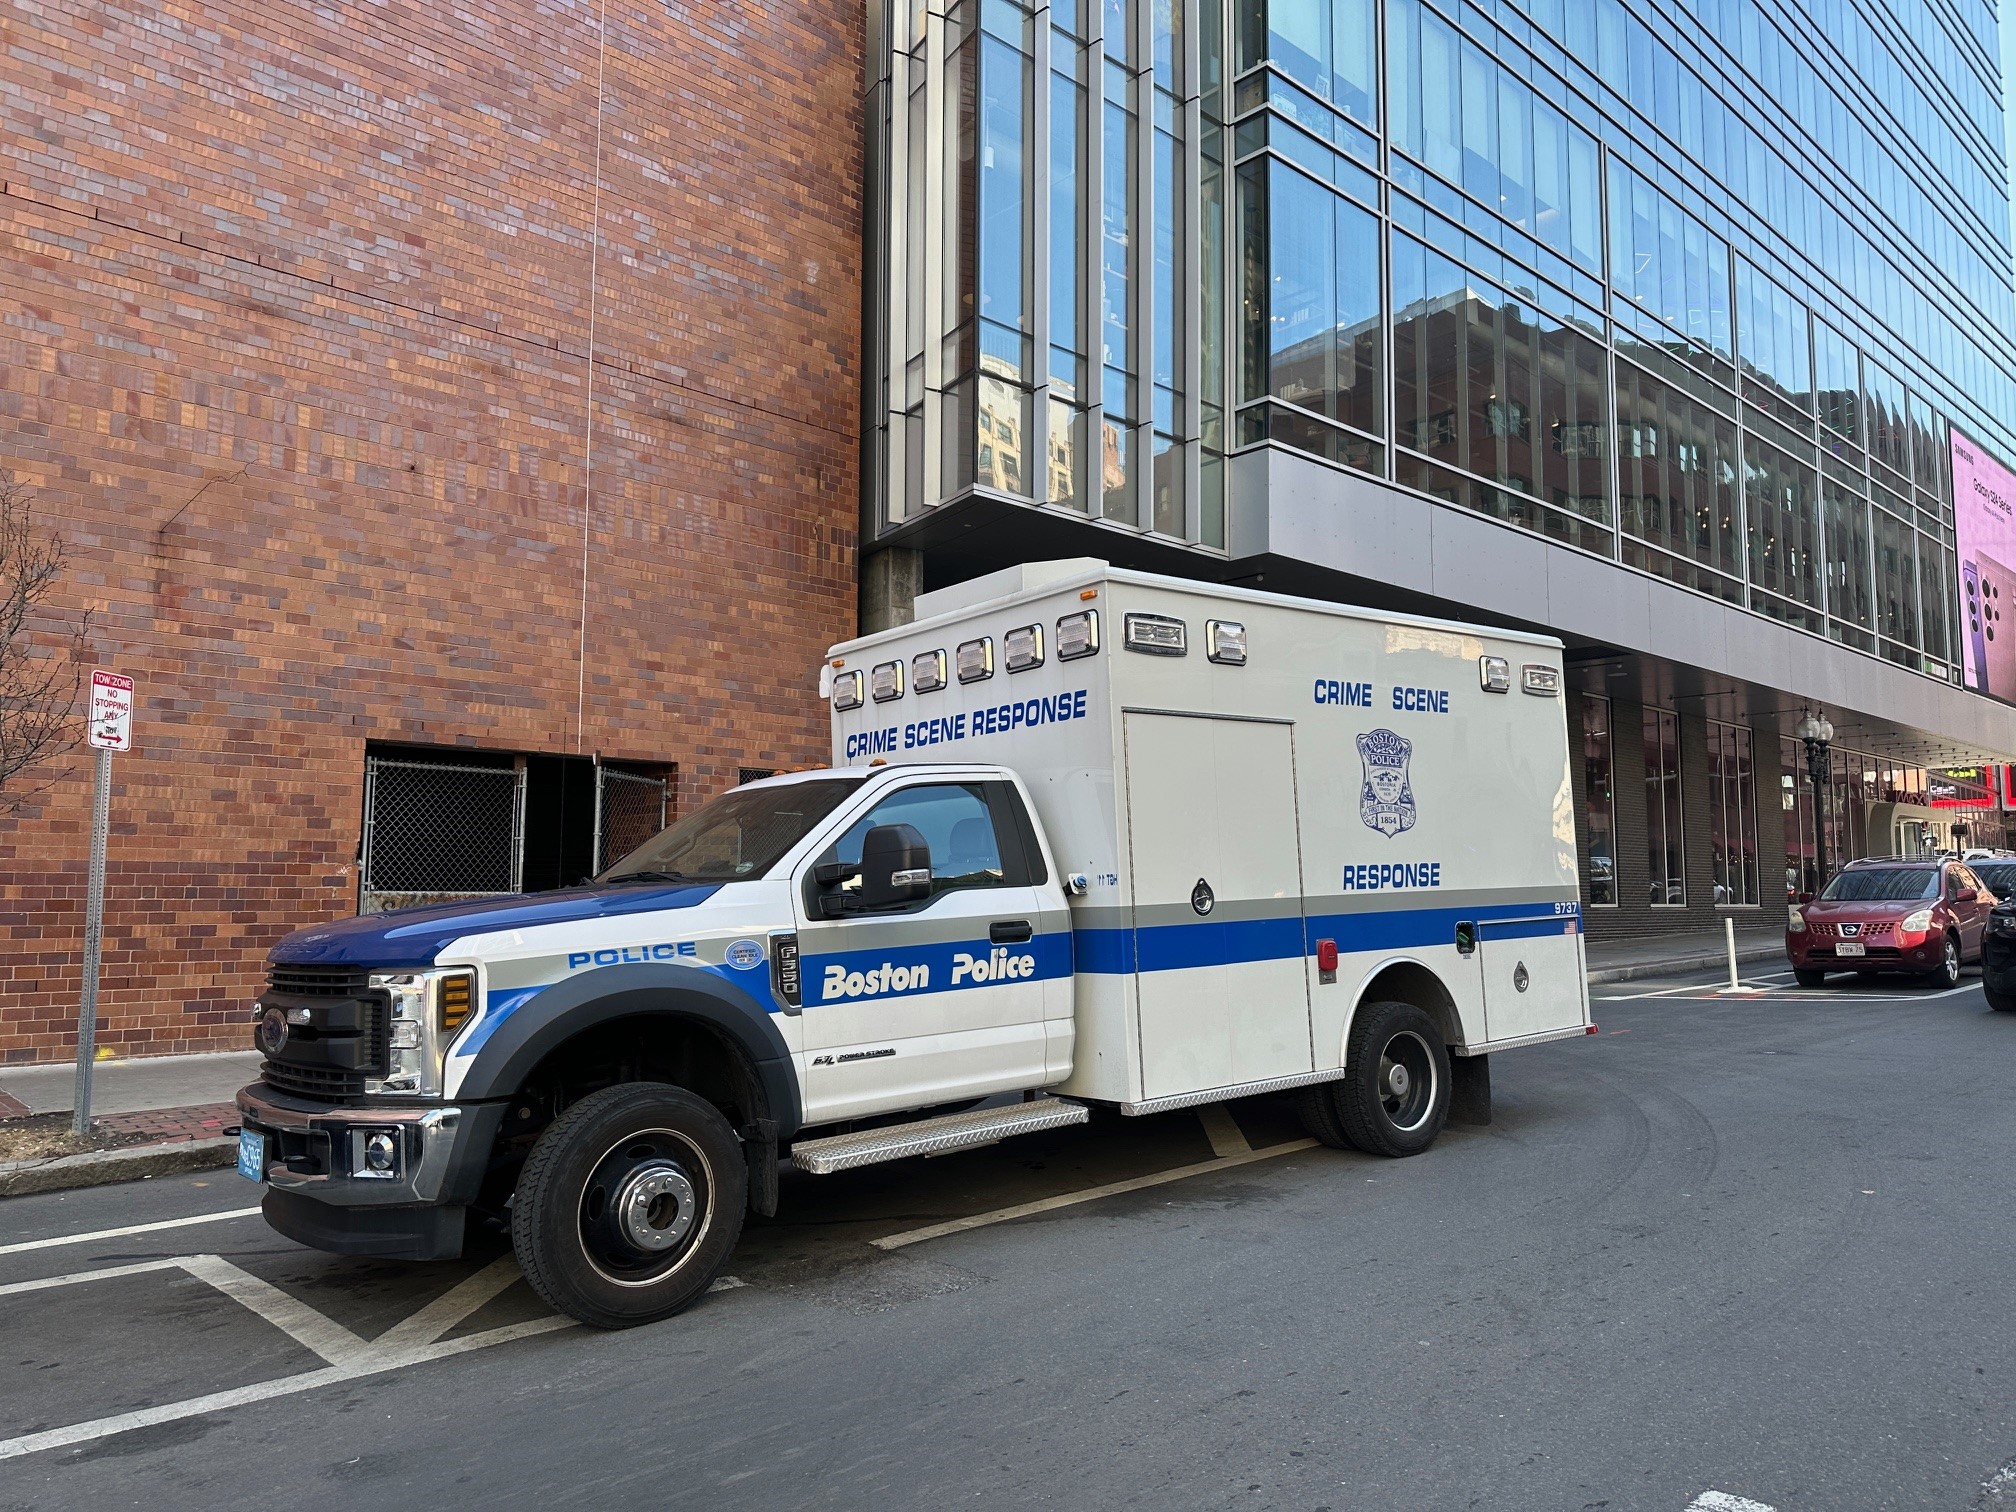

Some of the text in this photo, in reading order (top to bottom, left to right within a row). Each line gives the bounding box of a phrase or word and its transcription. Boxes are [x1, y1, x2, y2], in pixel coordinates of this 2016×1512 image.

[1955, 443, 1974, 466] SAMSUNG
[1973, 478, 1990, 504] Galaxy
[1999, 496, 2012, 516] Series
[94, 673, 132, 689] TOW ZONE
[95, 697, 129, 711] STOPPING
[107, 689, 118, 699] NO
[1314, 678, 1449, 713] CRIME SCENE
[104, 710, 119, 720] ANY
[846, 689, 1088, 758] CRIME SCENE RESPONSE
[1367, 733, 1403, 752] BOSTON
[1371, 754, 1400, 766] POLICE
[1380, 816, 1397, 824] 1854
[1343, 862, 1441, 890] RESPONSE
[1554, 901, 1577, 914] 9737
[568, 941, 697, 969] POLICE
[780, 946, 798, 994] F550
[822, 947, 1035, 1000] Boston Police
